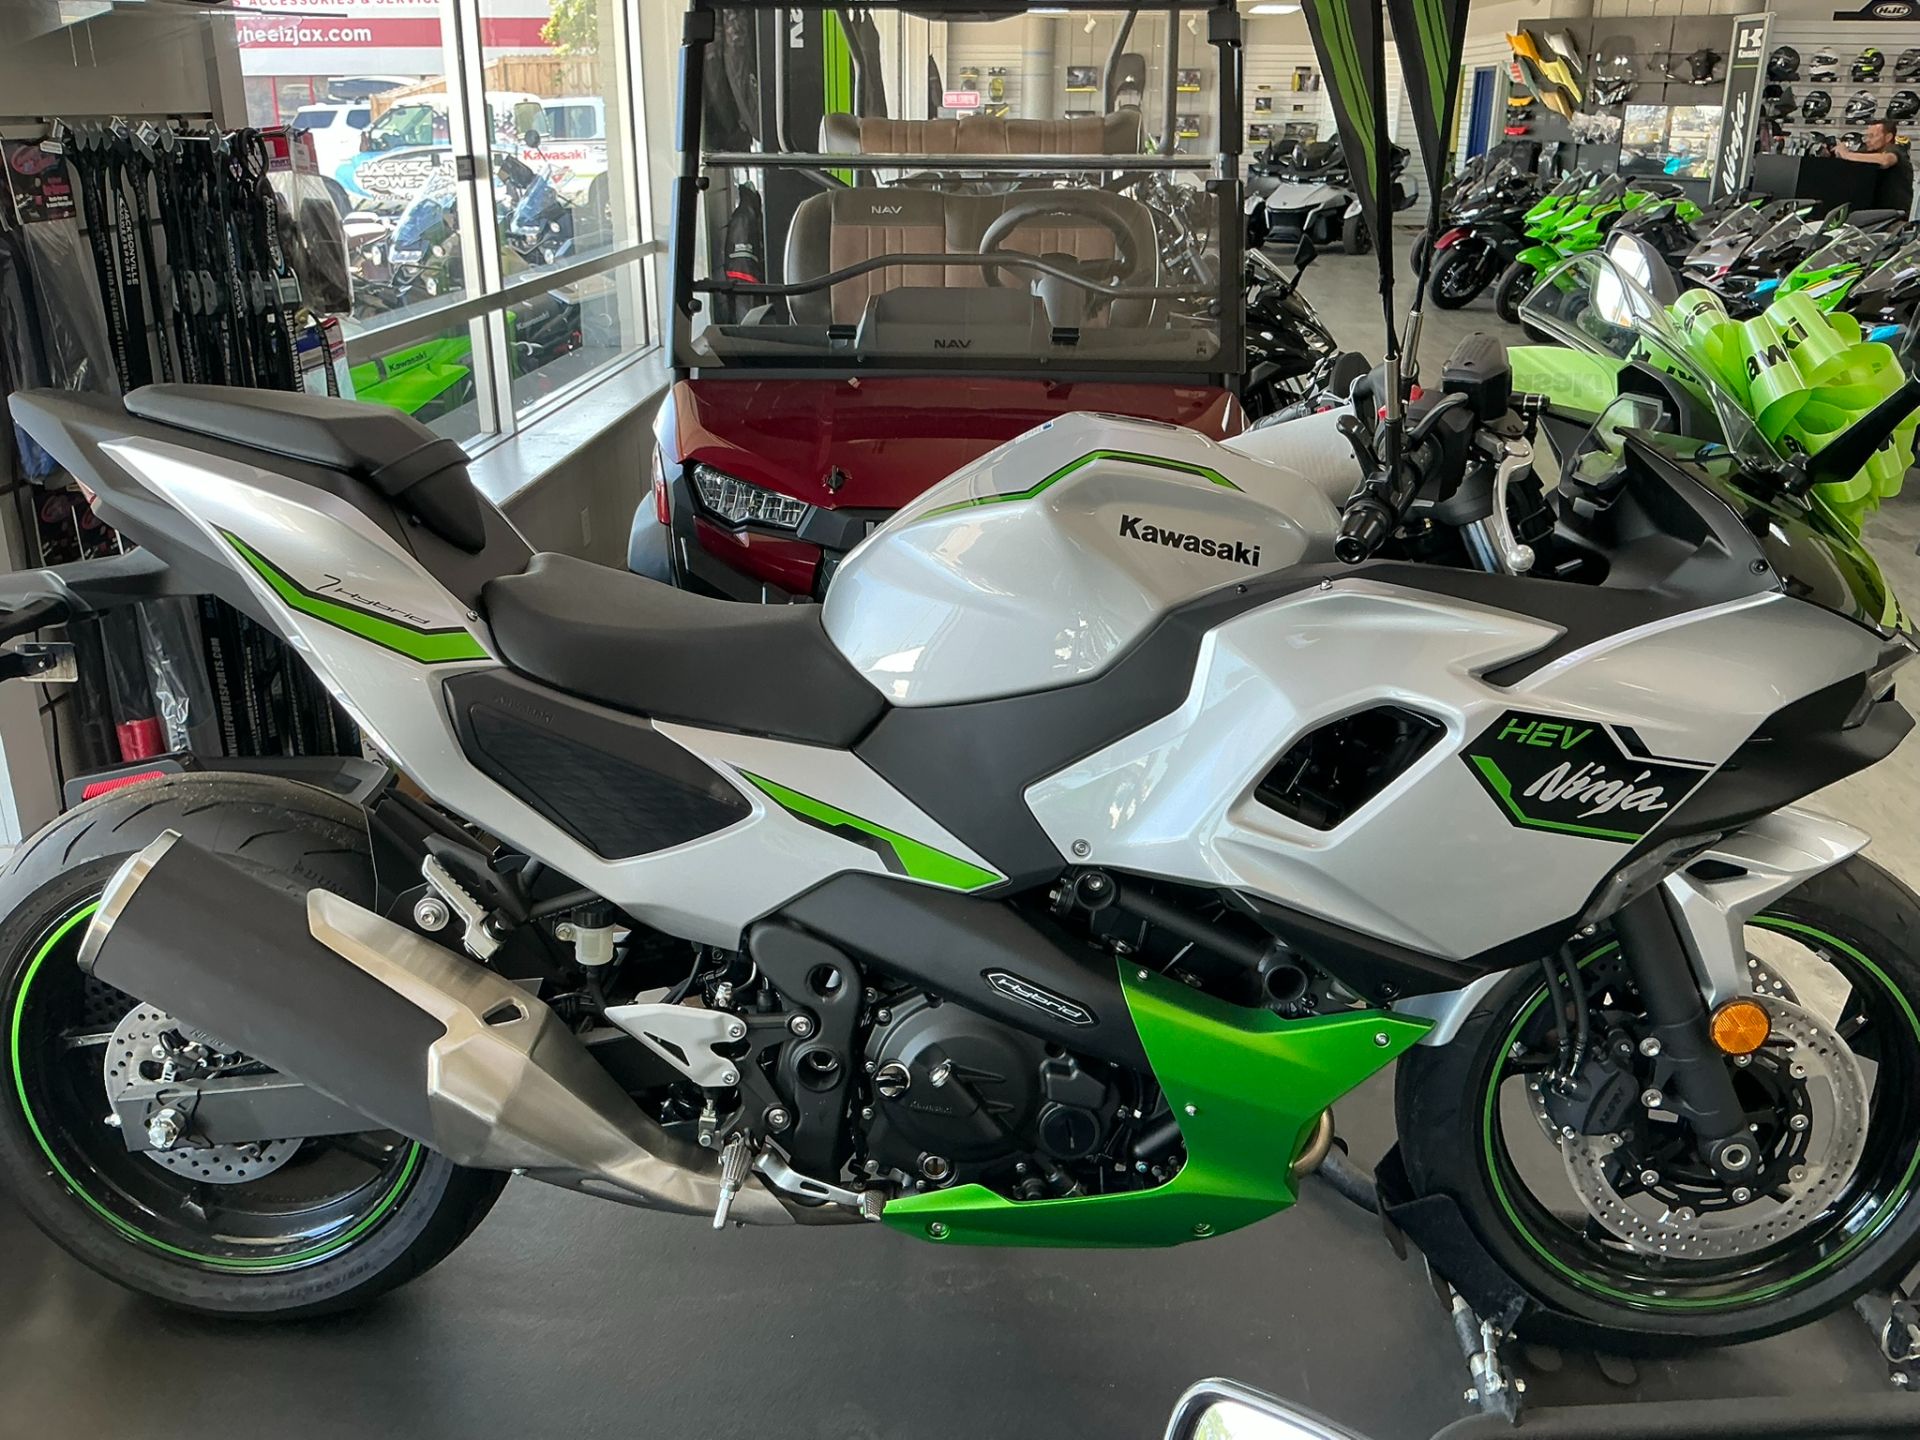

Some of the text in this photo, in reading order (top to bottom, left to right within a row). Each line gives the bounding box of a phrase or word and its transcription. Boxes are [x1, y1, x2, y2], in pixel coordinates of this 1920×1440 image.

[523, 149, 588, 161] Kawasaki
[1722, 91, 1747, 195] Ninja
[871, 205, 903, 215] NAV
[389, 351, 428, 373] Kawasaki
[934, 339, 973, 350] NAV
[1119, 514, 1261, 568] Kawasaki
[334, 587, 431, 625] Hybrid
[1497, 718, 1595, 750] HEV
[1522, 761, 1669, 819] Ninja
[997, 978, 1083, 1018] Hybrid
